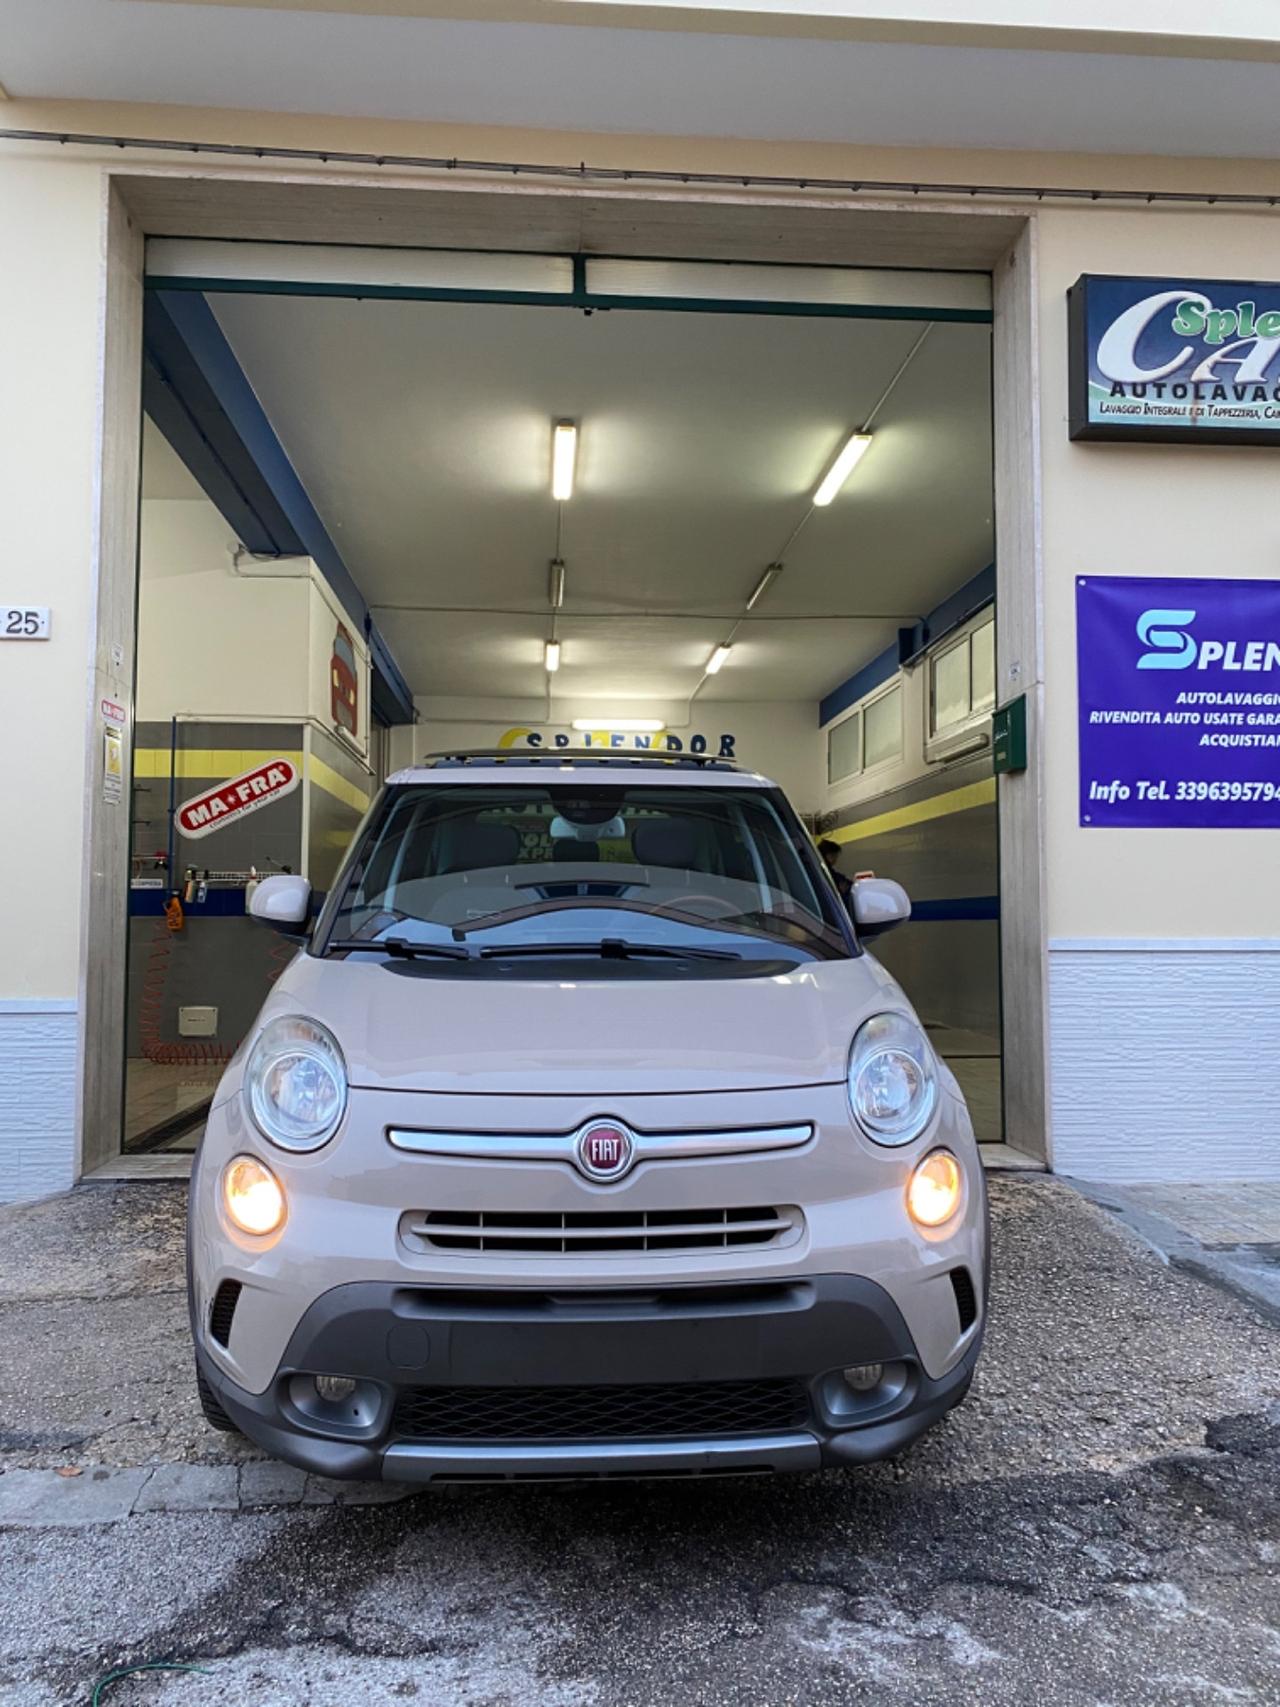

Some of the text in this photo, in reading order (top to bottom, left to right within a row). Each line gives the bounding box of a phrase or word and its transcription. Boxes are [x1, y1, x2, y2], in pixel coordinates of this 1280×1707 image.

[1097, 290, 1280, 384] CA
[6, 610, 40, 635] 25
[1176, 692, 1280, 706] AUTOLAVAGGI
[1090, 711, 1161, 724] RIVENDITA
[1163, 712, 1200, 724] AUTO
[1203, 712, 1244, 725] USATE
[1199, 733, 1280, 747] ACQUISTIA
[1089, 780, 1130, 804] Info
[592, 1139, 619, 1161] FIAT
